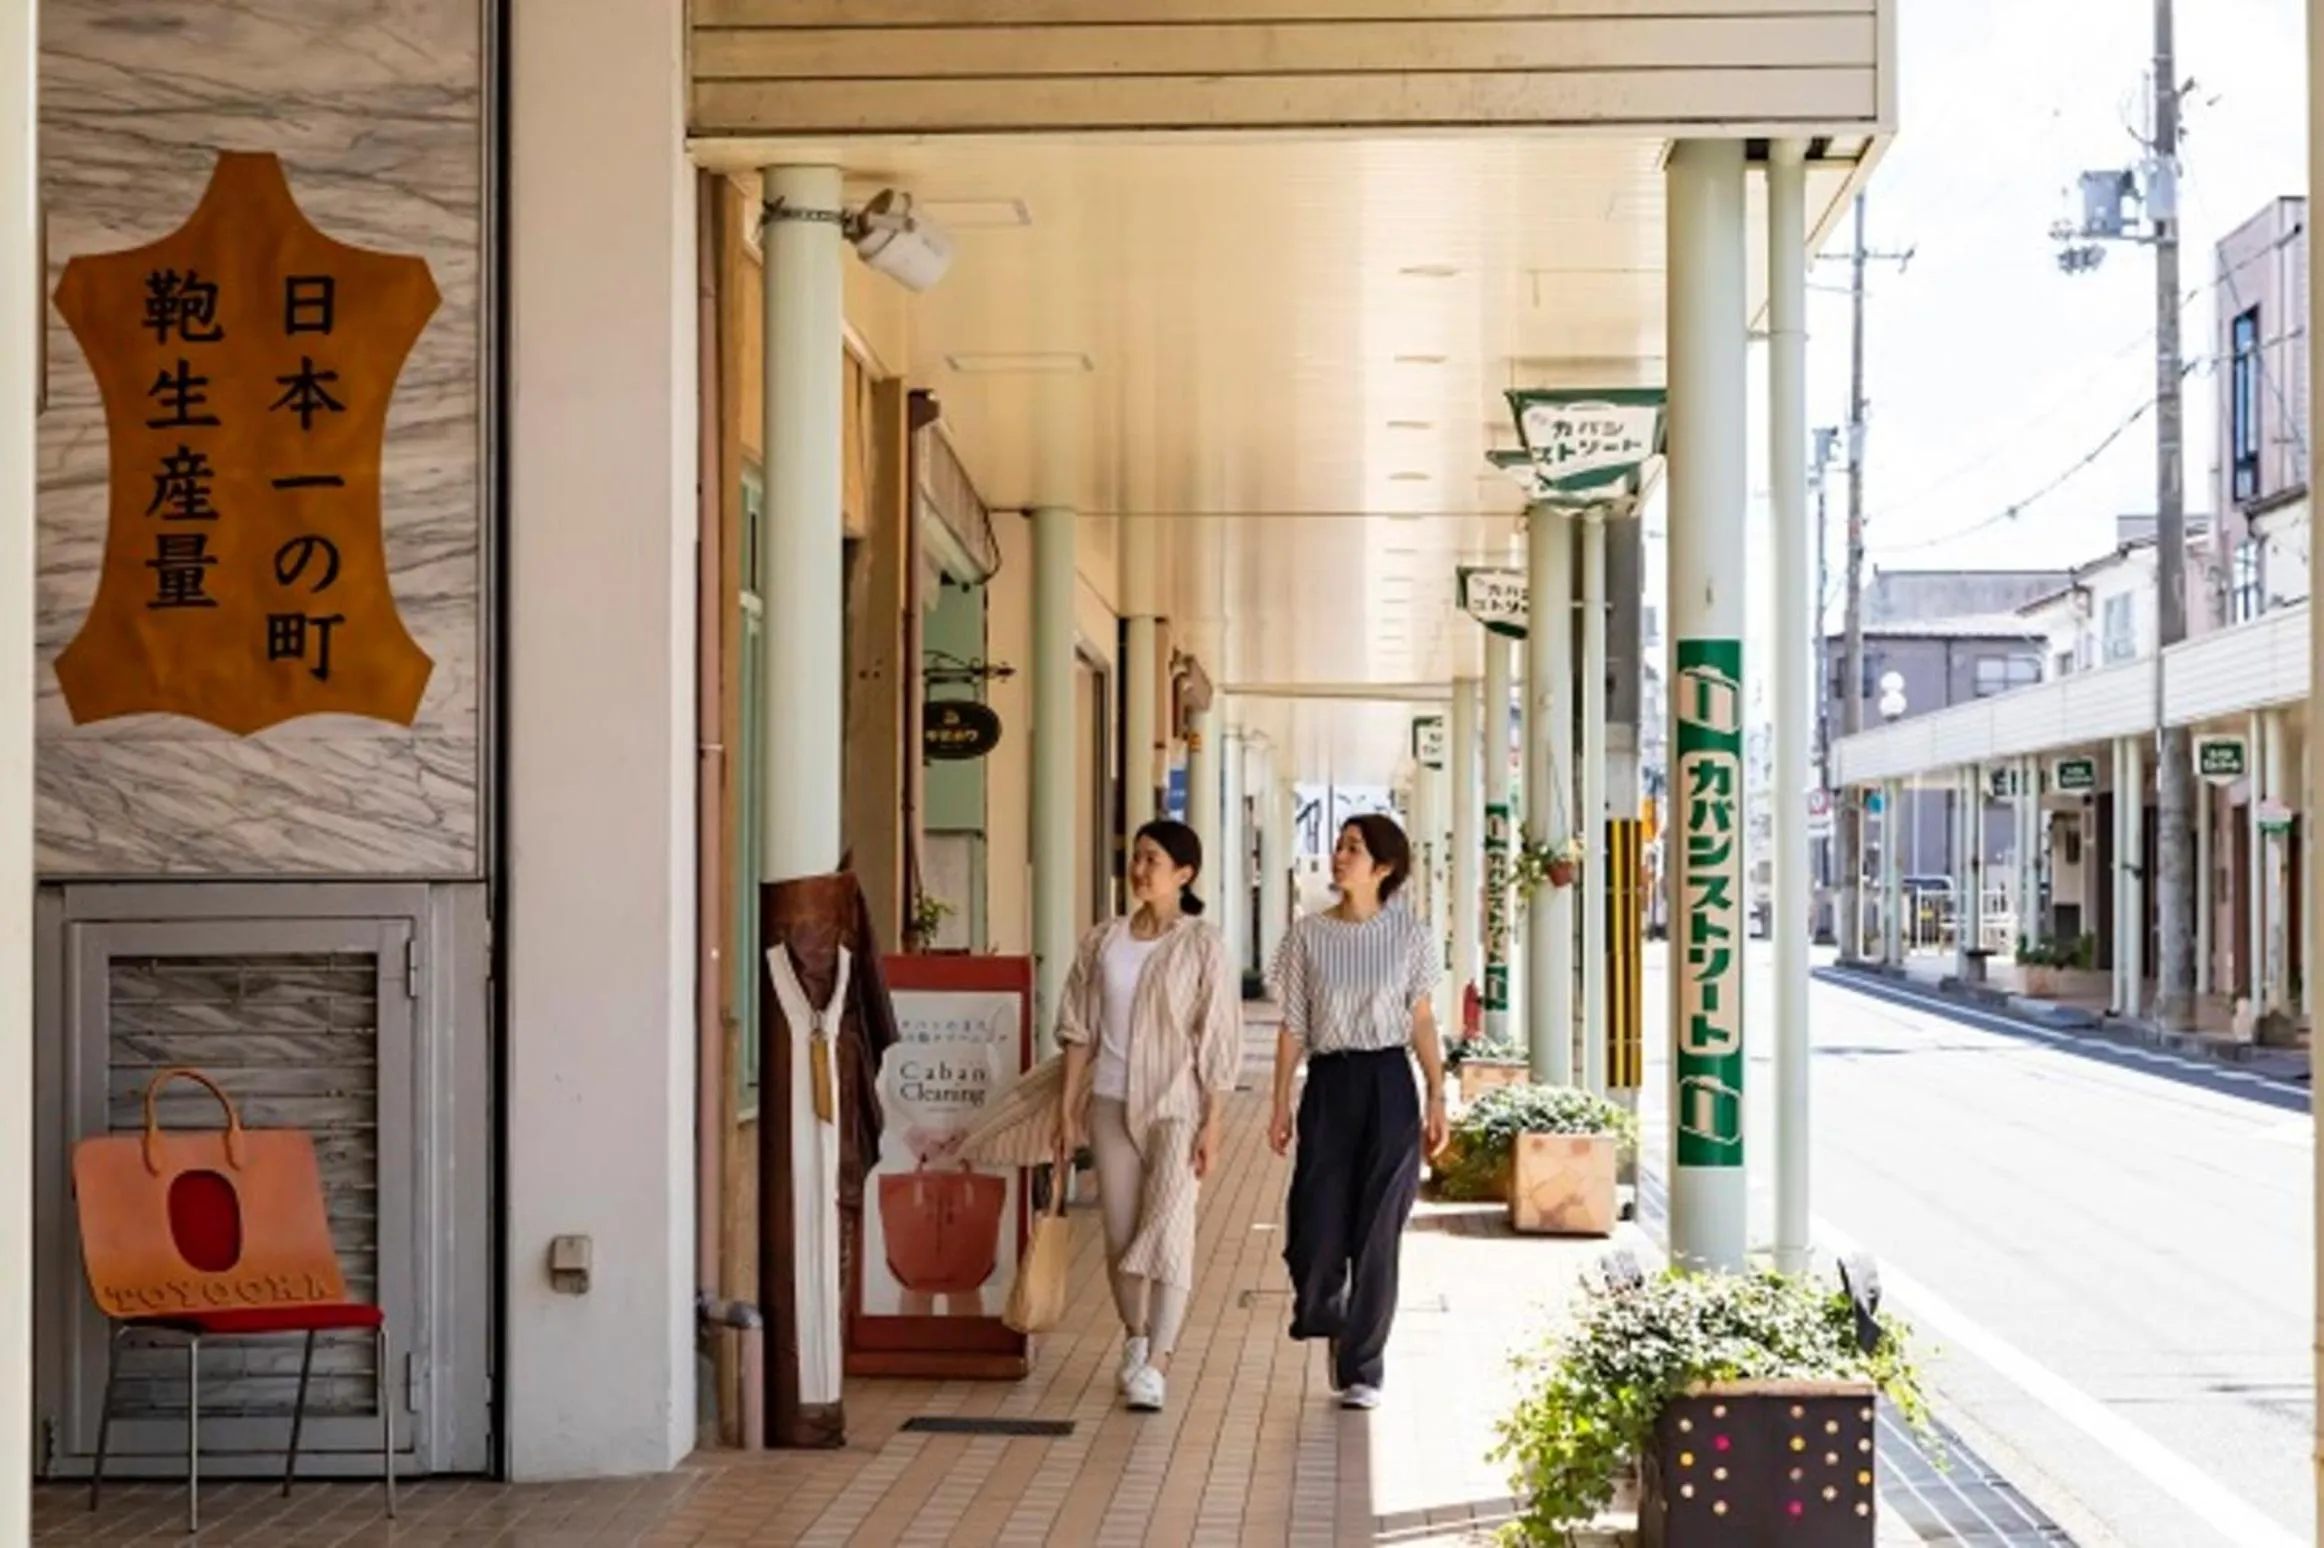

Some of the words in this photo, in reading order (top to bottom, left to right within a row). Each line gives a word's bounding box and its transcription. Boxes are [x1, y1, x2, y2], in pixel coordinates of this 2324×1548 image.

[142, 268, 226, 611] 鞄生産量
[266, 274, 348, 683] 日本一の町
[1687, 758, 1736, 1050] カバンストリート
[901, 1061, 985, 1080] Caban
[901, 1083, 985, 1106] Cleaning
